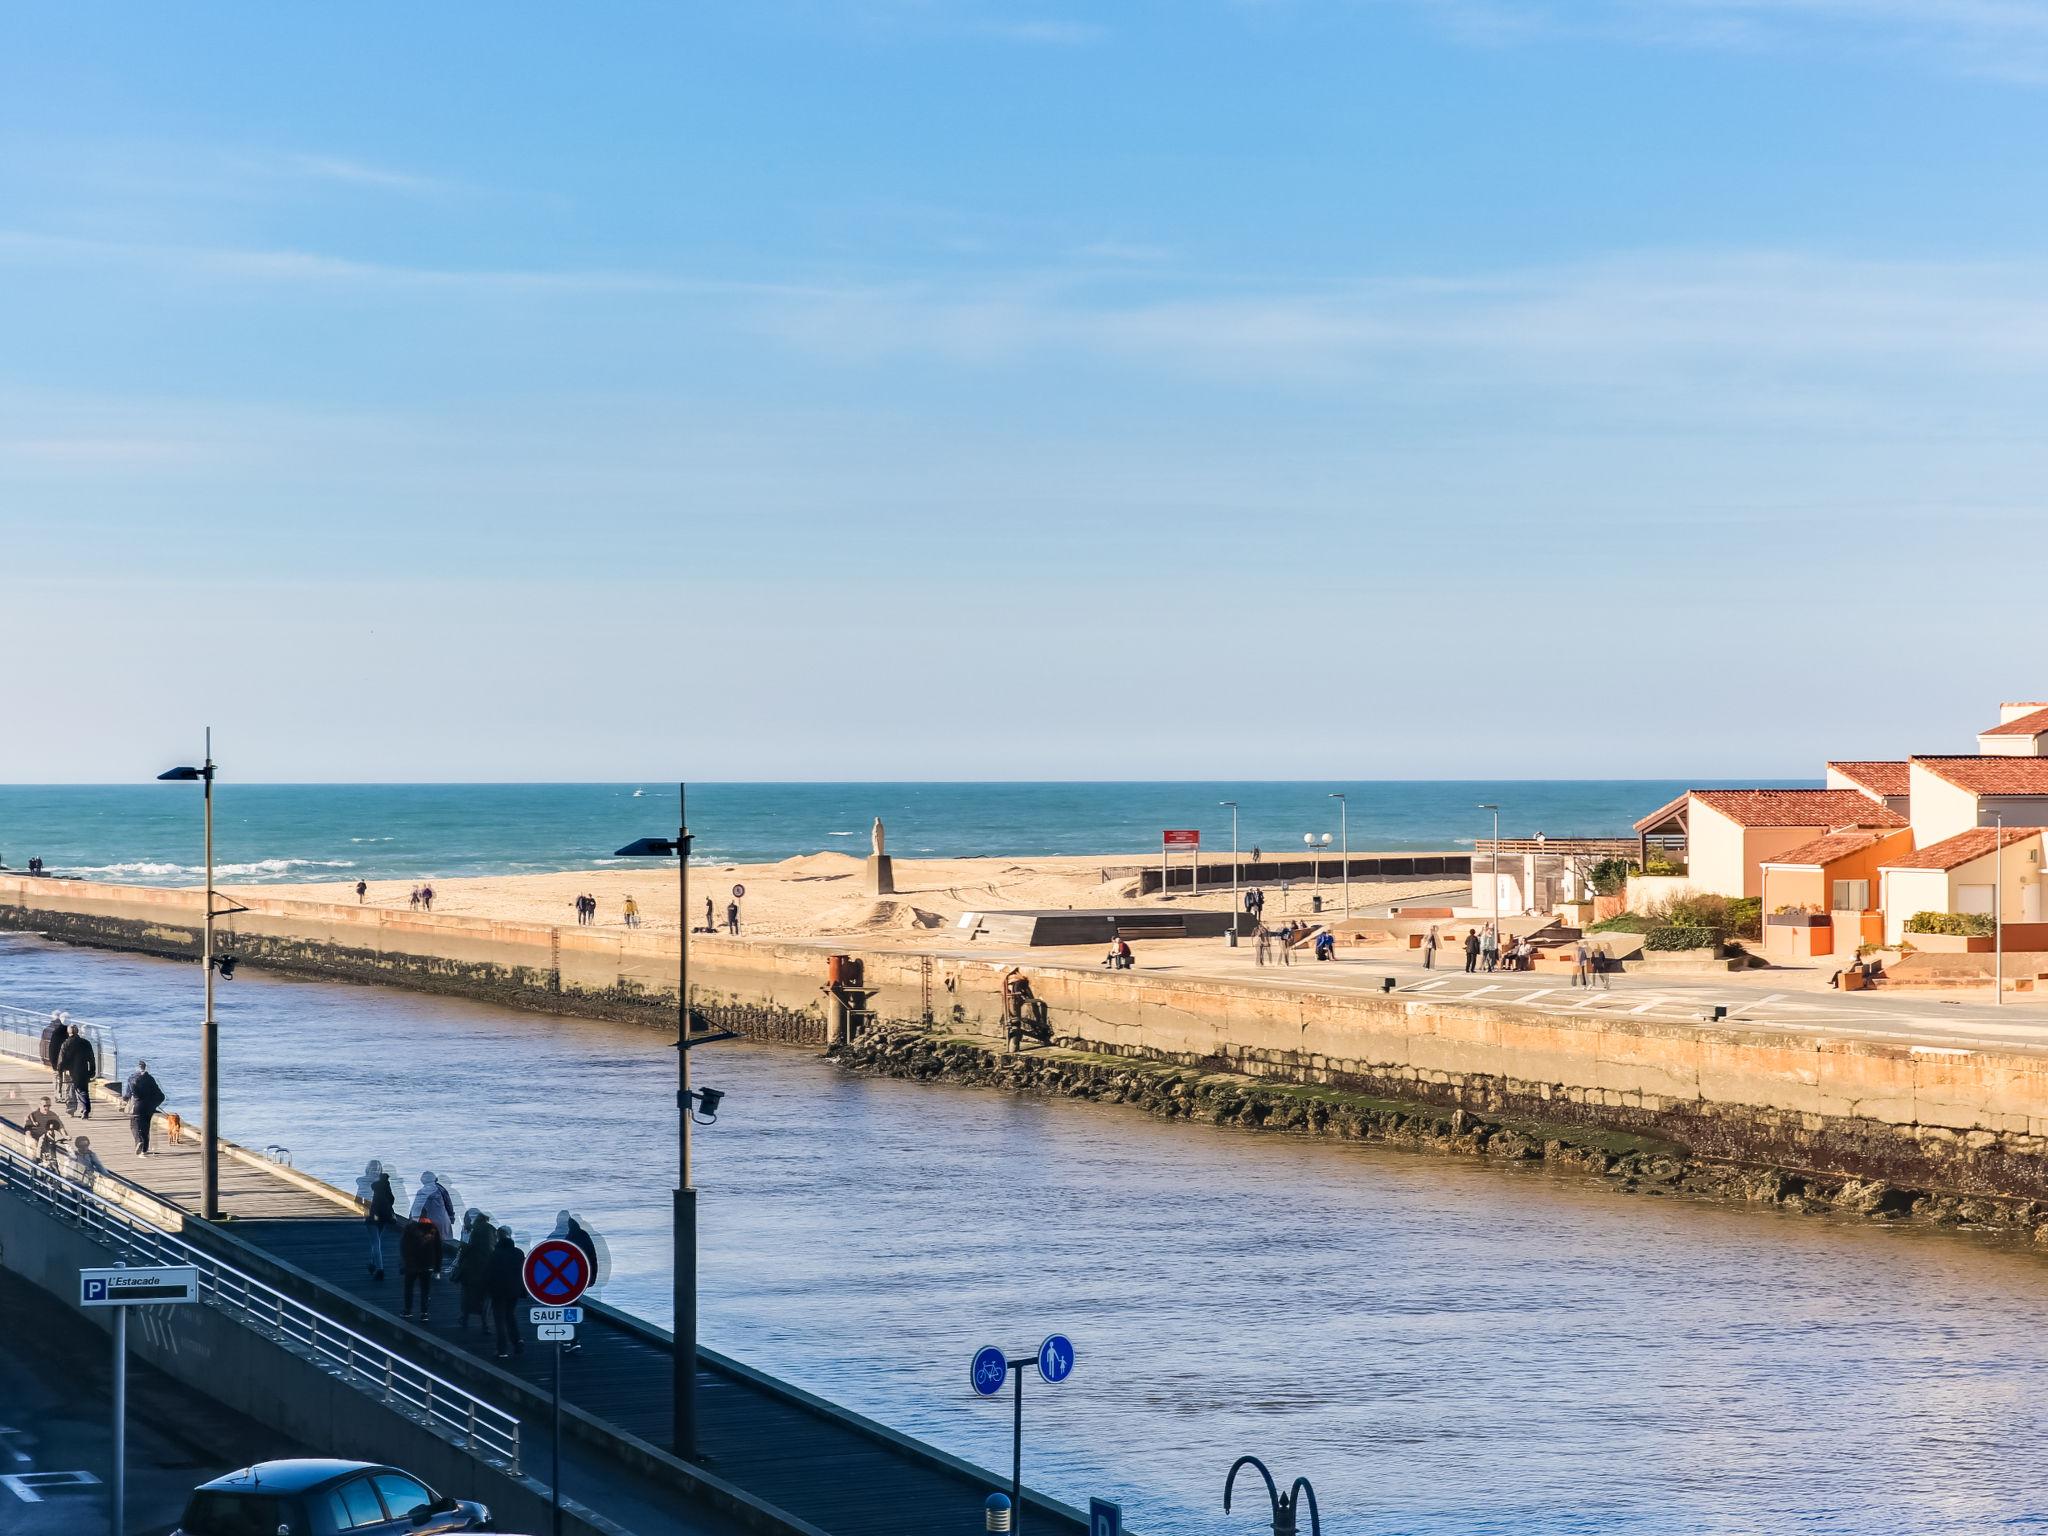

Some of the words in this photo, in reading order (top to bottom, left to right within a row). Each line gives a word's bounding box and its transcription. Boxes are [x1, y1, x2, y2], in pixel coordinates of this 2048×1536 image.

[108, 1276, 160, 1287] L'Estacade
[89, 1282, 101, 1298] P
[533, 1311, 563, 1321] SAUF
